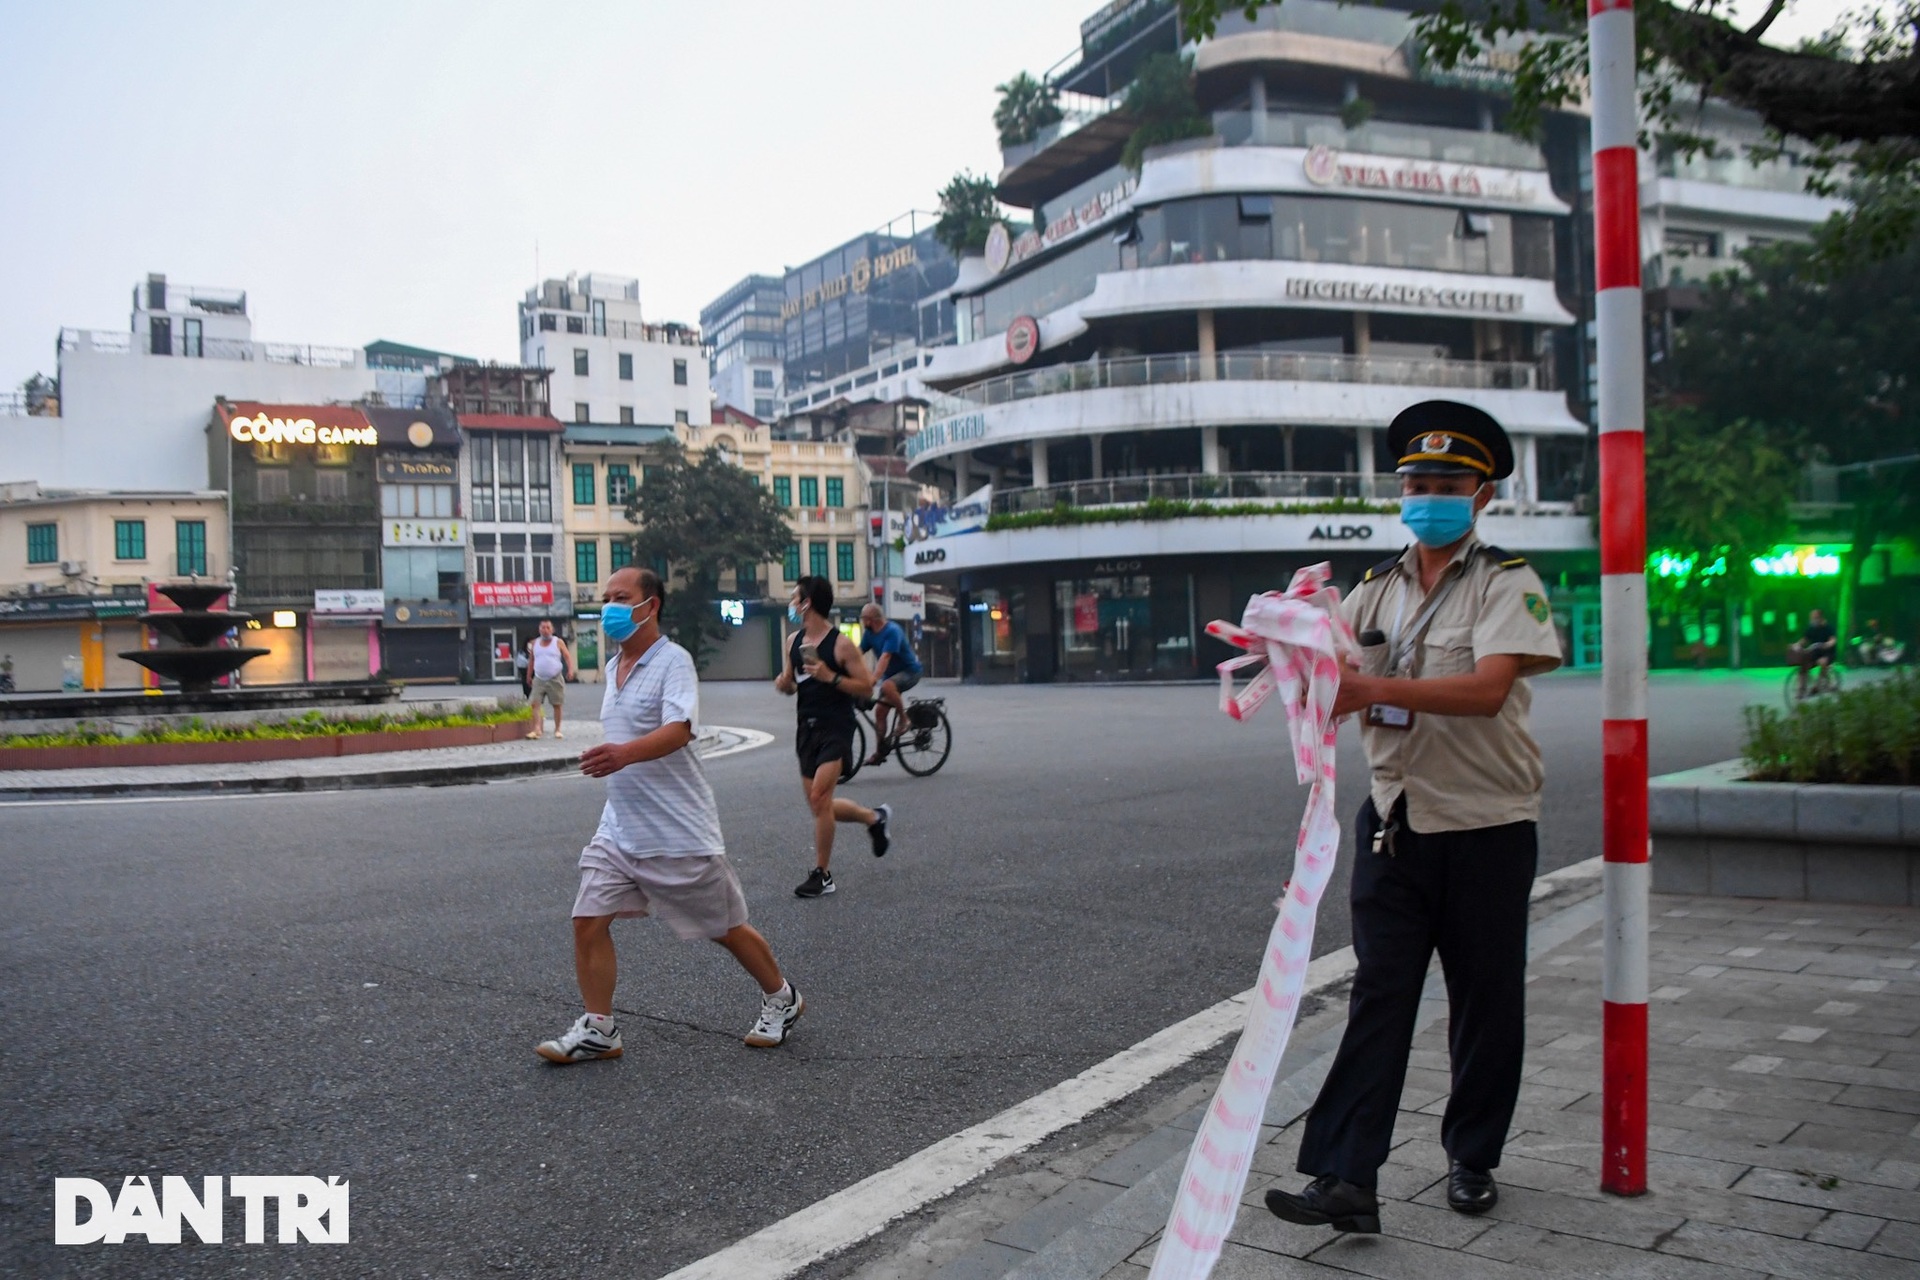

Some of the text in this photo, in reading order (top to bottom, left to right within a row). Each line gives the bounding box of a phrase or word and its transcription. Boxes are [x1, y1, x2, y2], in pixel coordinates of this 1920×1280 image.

[873, 243, 917, 279] HOTEL
[1286, 277, 1431, 308] HIGHLANDS
[1308, 524, 1373, 540] ALDO
[914, 548, 946, 565] ALDO
[1095, 561, 1141, 572] ALDO
